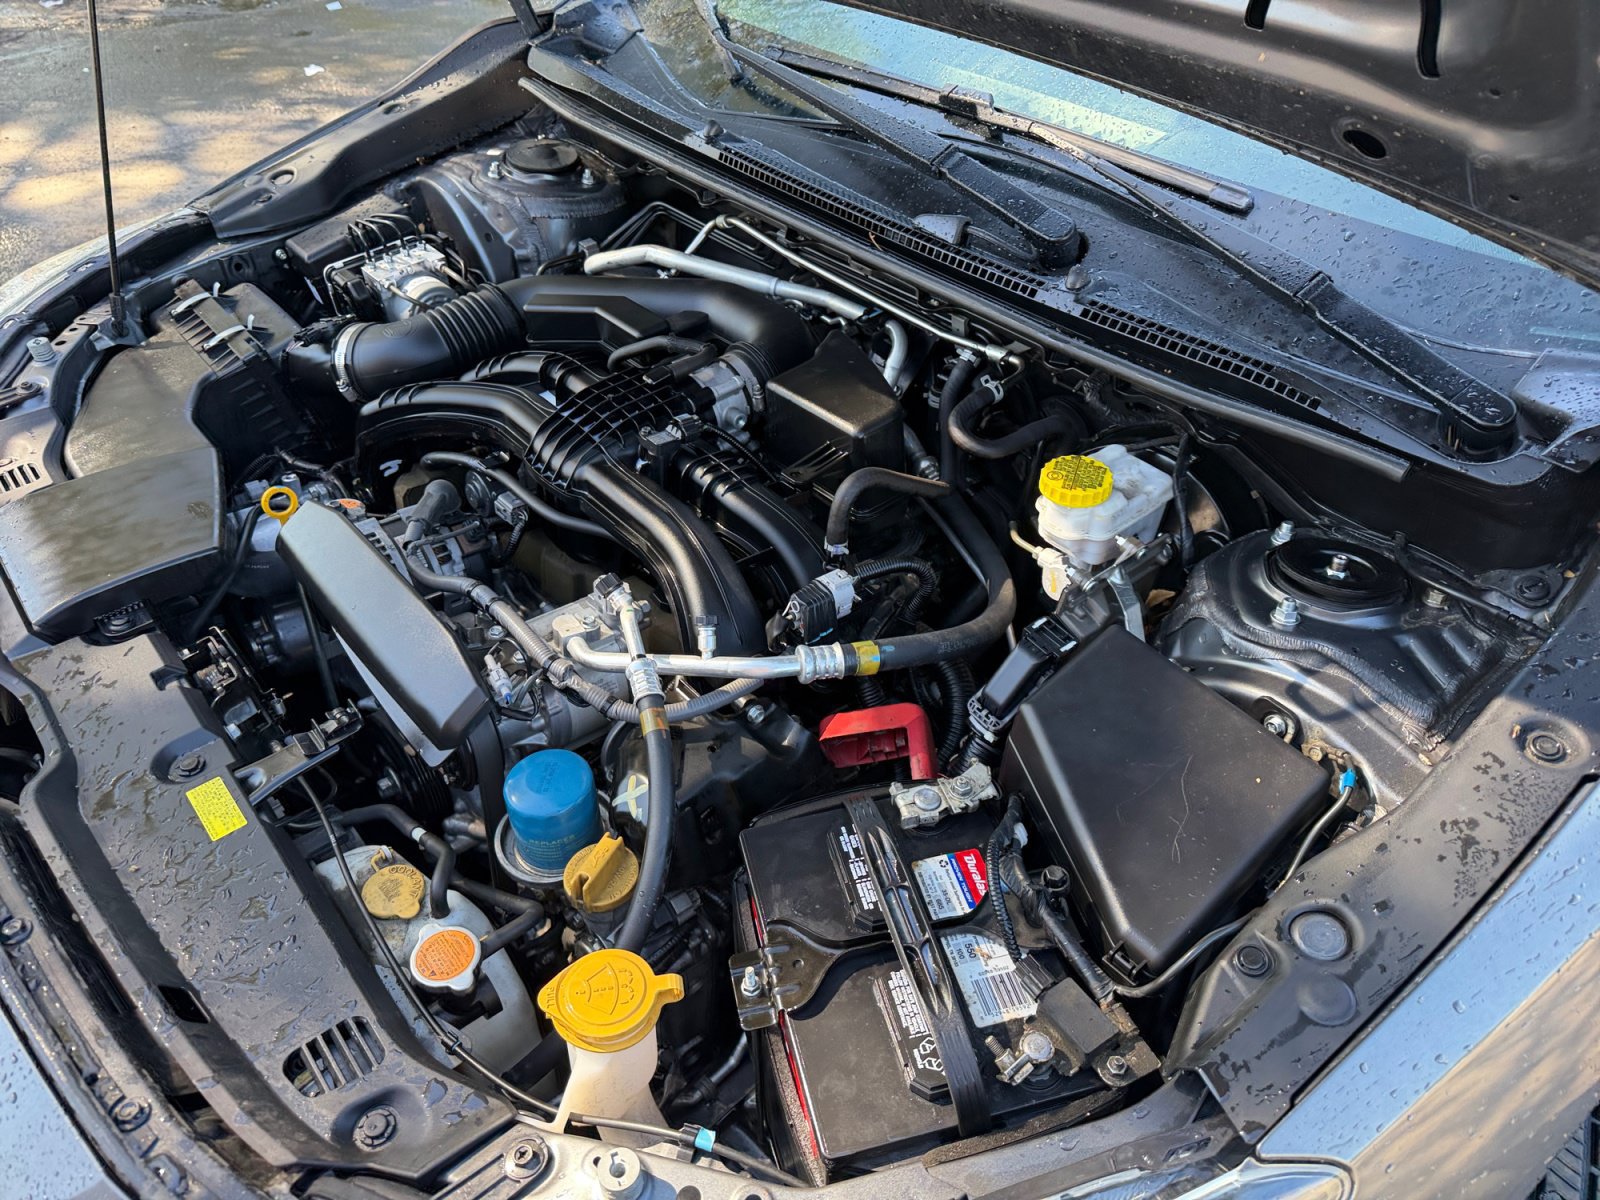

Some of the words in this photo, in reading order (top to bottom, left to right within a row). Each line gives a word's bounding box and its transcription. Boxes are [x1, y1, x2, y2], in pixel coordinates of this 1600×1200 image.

[388, 864, 421, 898] COOLANT
[949, 858, 963, 881] PROVEN
[959, 881, 973, 902] TOUGH
[963, 854, 987, 897] Duralas
[955, 947, 965, 960] 100
[963, 942, 977, 959] 550
[546, 986, 555, 1008] PULL
